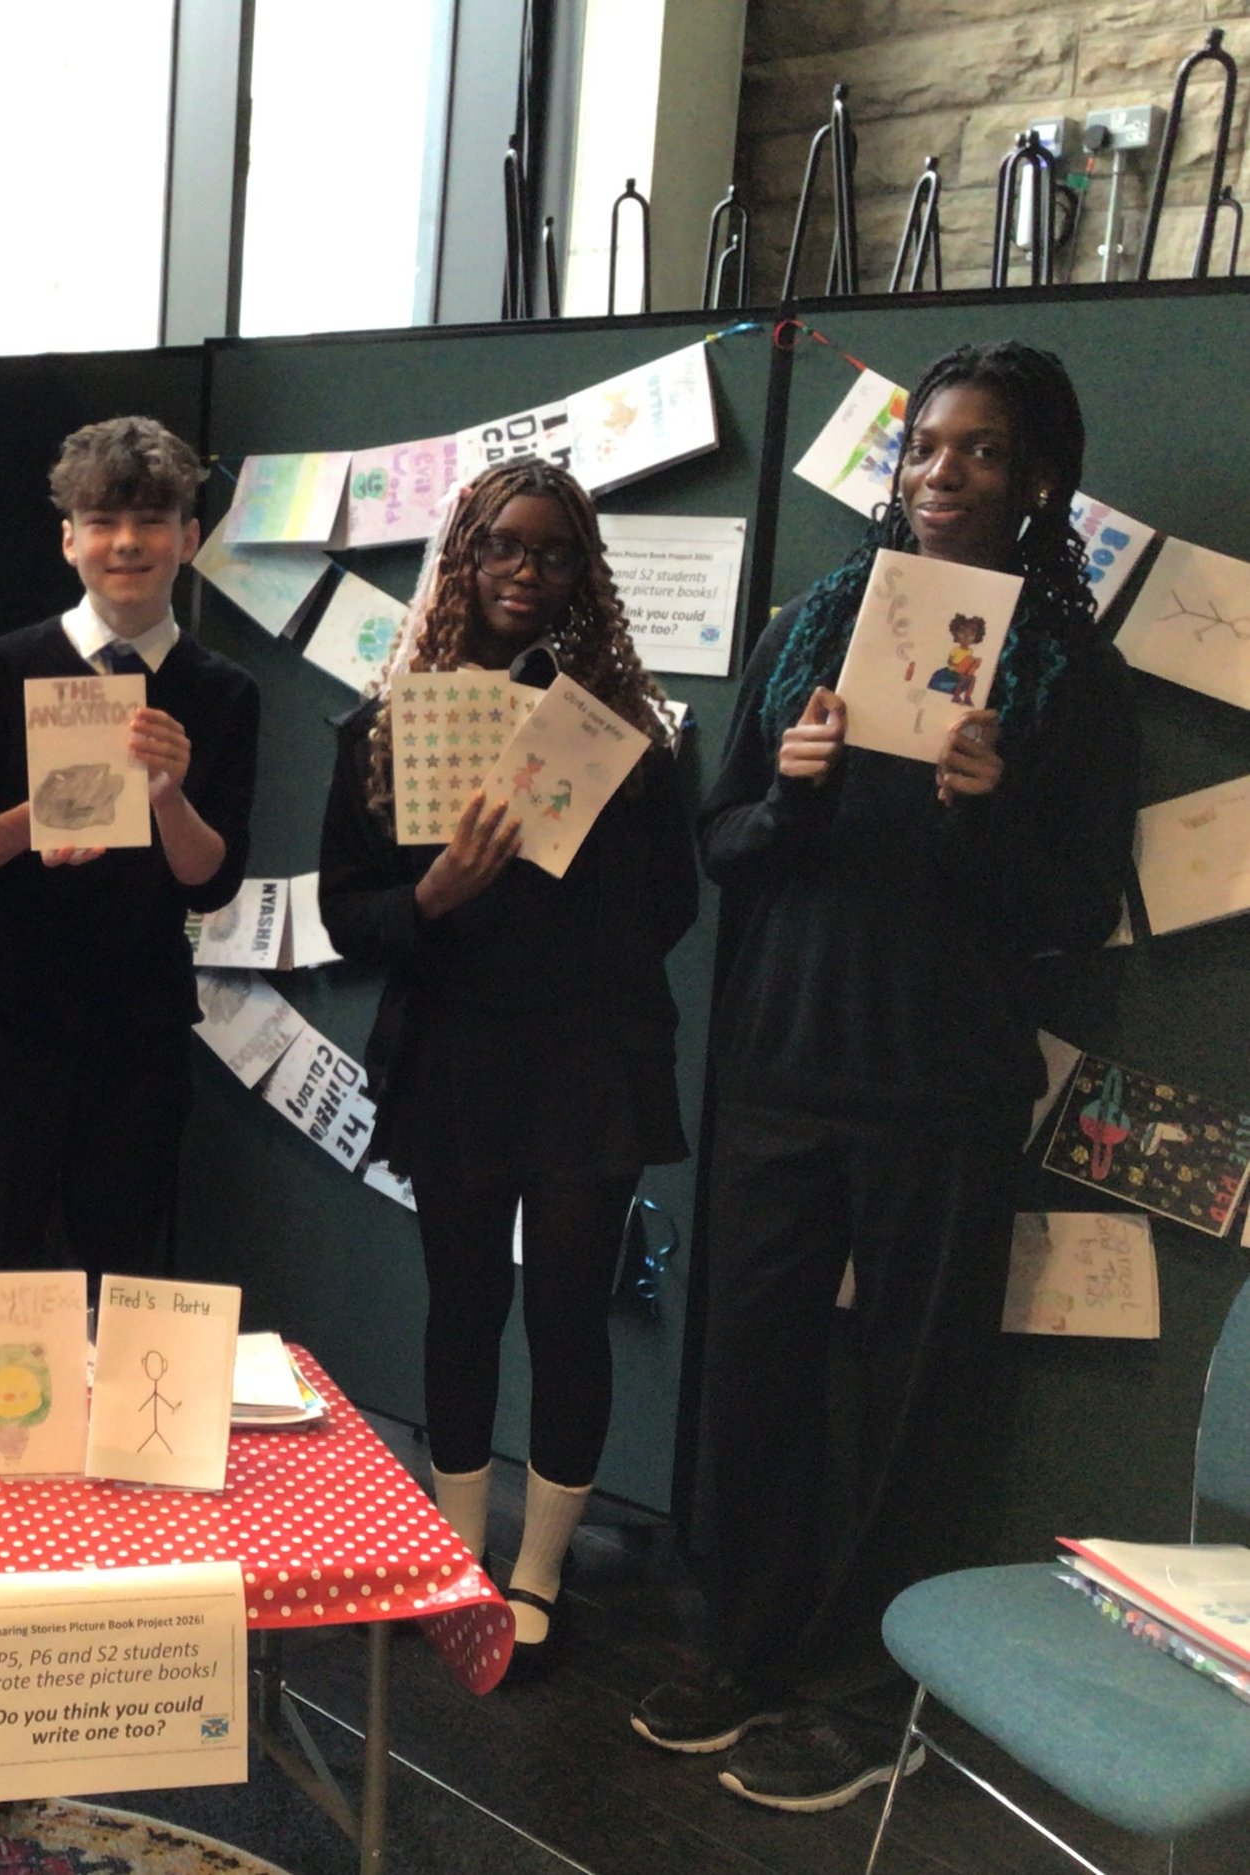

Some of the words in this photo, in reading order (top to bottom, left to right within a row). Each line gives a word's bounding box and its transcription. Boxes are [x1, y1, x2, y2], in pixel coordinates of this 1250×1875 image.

[639, 569, 654, 580] S2
[657, 570, 707, 583] students
[633, 585, 674, 597] picture
[677, 586, 717, 599] books!
[646, 610, 669, 621] you
[672, 609, 705, 622] could
[651, 623, 678, 635] too?
[109, 1288, 155, 1310] Fred's
[31, 1623, 66, 1634] Stories
[70, 1621, 105, 1632] Picture
[109, 1618, 134, 1629] Book
[138, 1616, 173, 1628] Project
[176, 1615, 204, 1625] 2026!
[30, 1649, 52, 1665] P6
[58, 1646, 92, 1663] and
[97, 1645, 117, 1662] S2
[123, 1641, 199, 1660] students
[37, 1669, 85, 1687] these
[90, 1666, 152, 1688] picture
[158, 1662, 217, 1679] books!
[24, 1708, 57, 1727] you
[63, 1701, 109, 1720] think
[116, 1702, 148, 1720] you
[154, 1696, 203, 1714] could
[32, 1725, 79, 1745] write
[86, 1725, 118, 1740] one
[125, 1720, 166, 1738] too?
